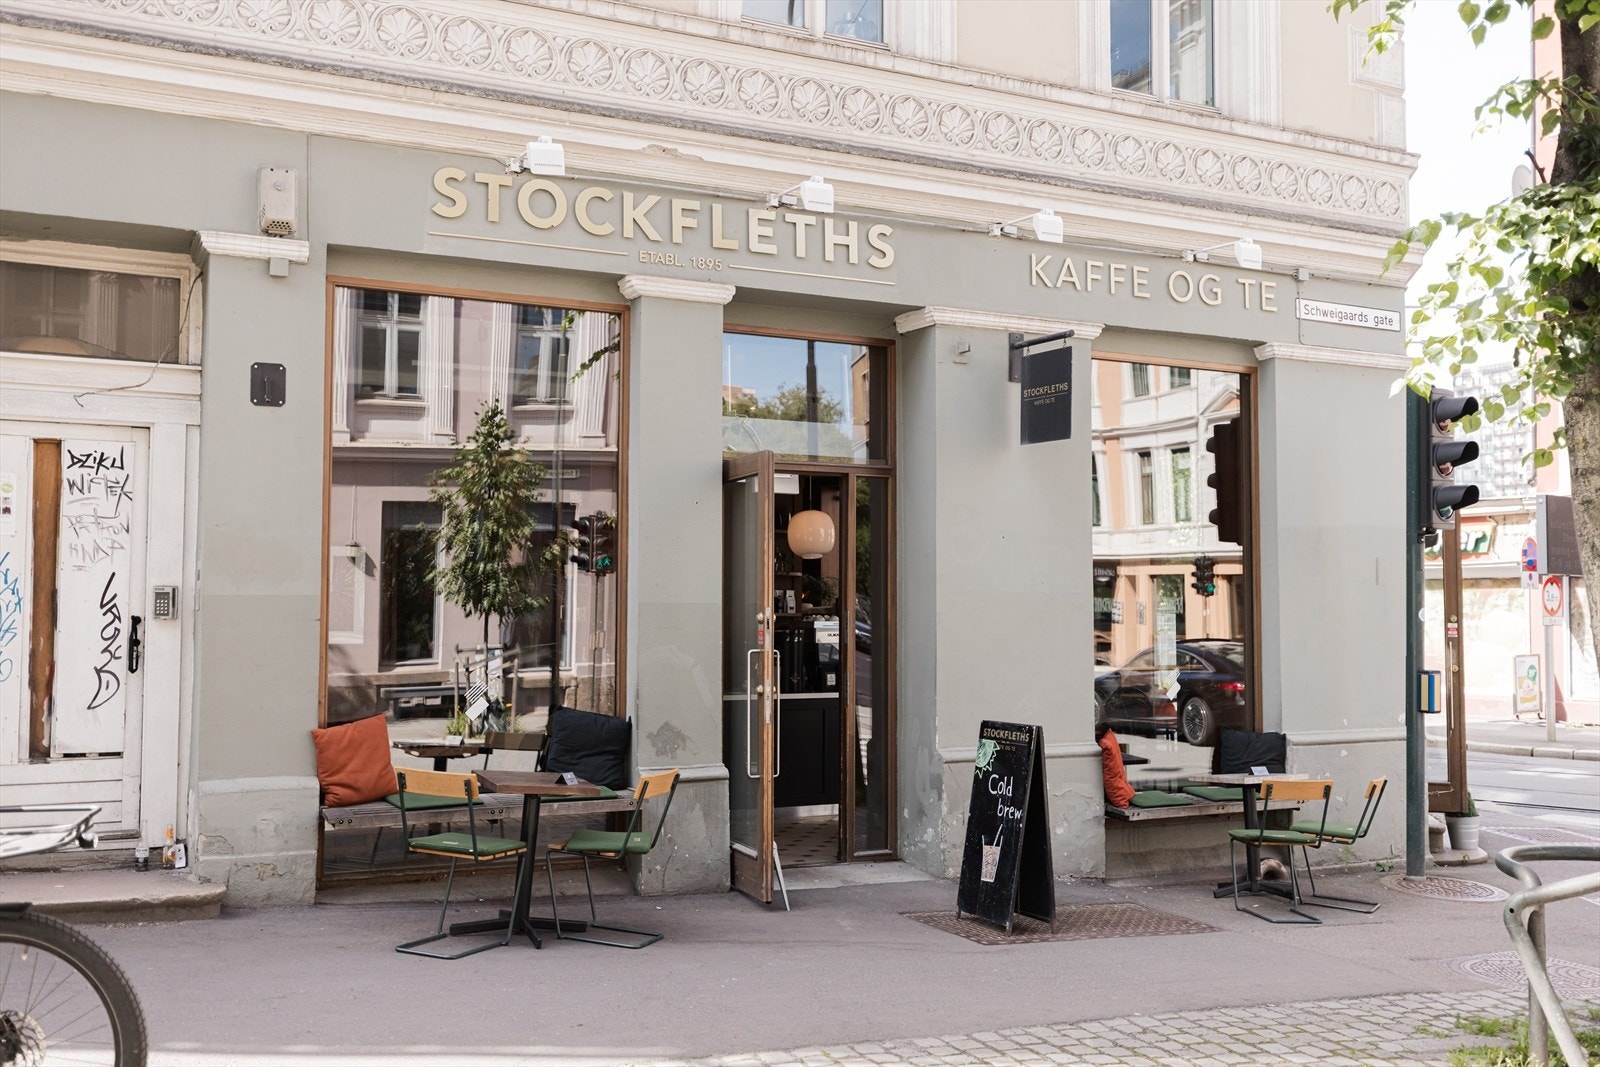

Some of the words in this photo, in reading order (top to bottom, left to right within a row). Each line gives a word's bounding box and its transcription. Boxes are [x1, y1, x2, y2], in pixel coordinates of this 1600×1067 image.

[432, 167, 895, 269] STOCKFLETHS
[638, 250, 685, 267] ETABL.
[690, 255, 723, 271] 1895
[1030, 253, 1151, 299] KAFFE
[1168, 269, 1222, 306] OG
[1237, 278, 1278, 312] TE
[1303, 303, 1369, 324] Schweigaards
[1374, 313, 1394, 327] gate
[1023, 382, 1068, 398] STOCKFLETHS
[983, 728, 1030, 742] STOCKFLETHS
[988, 773, 1013, 797] Cold
[997, 798, 1023, 820] brew
